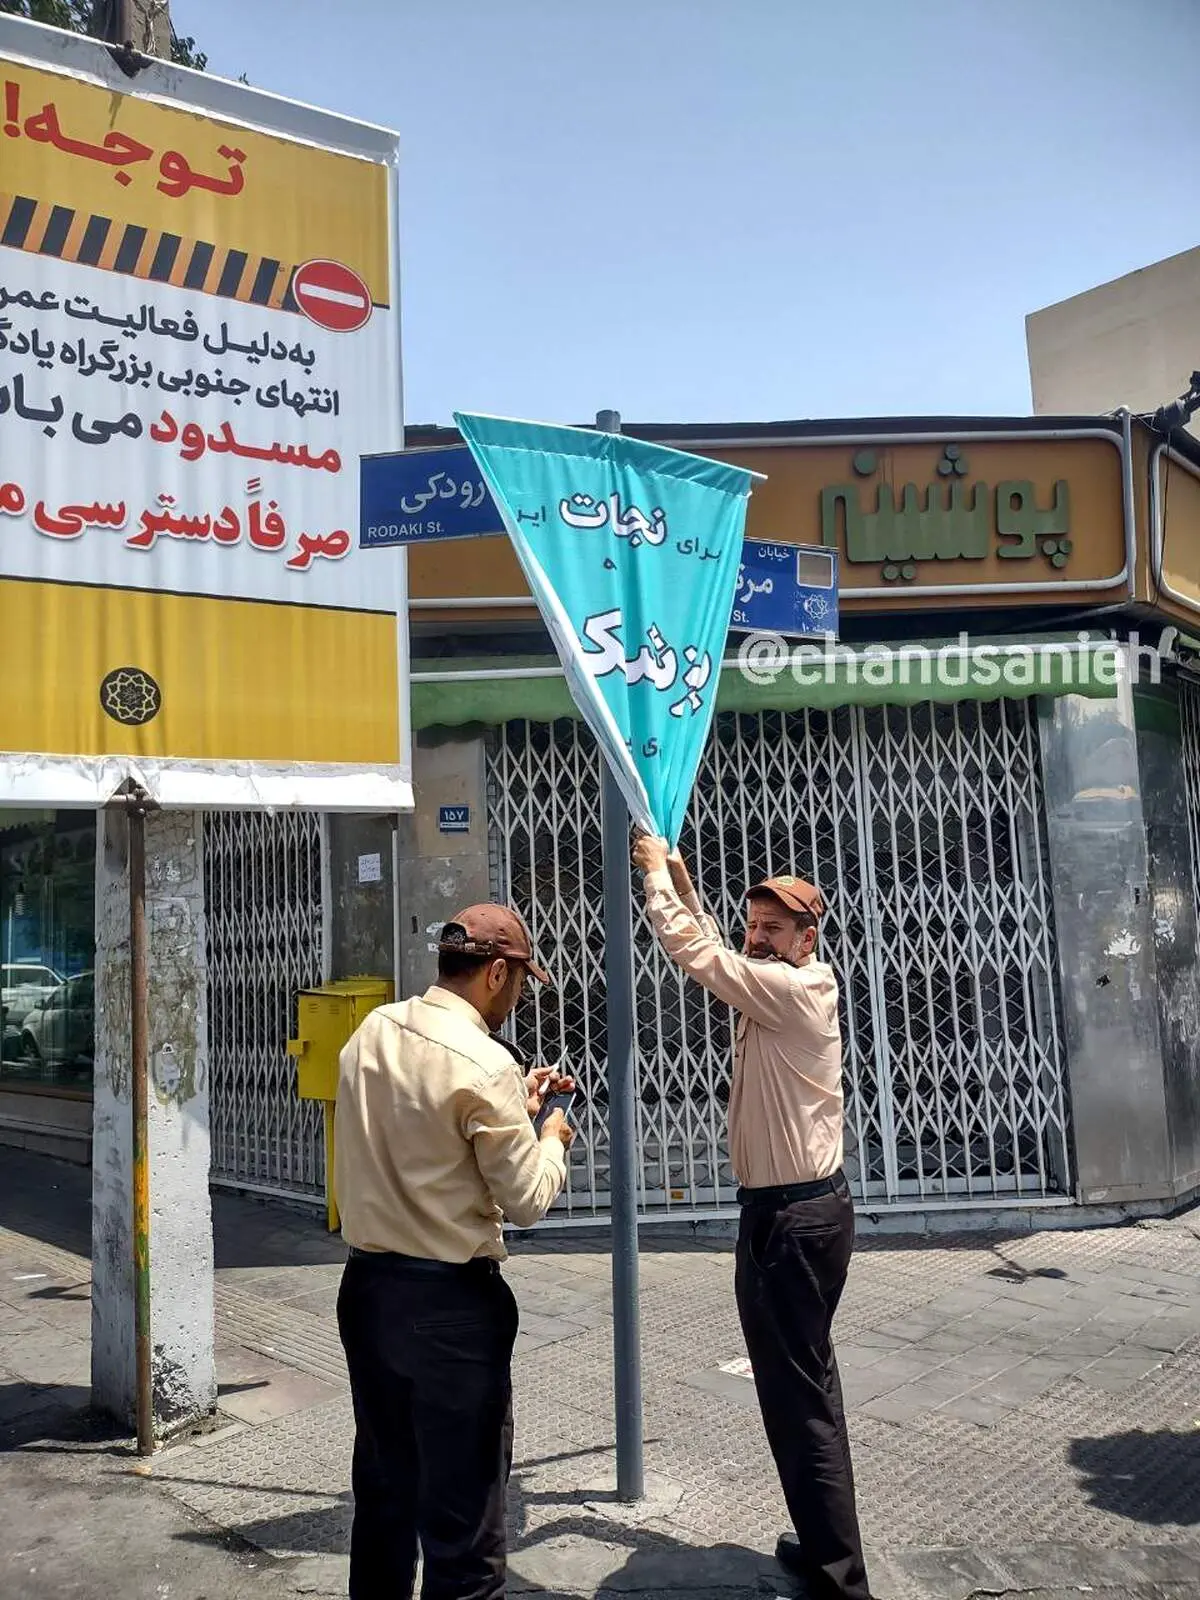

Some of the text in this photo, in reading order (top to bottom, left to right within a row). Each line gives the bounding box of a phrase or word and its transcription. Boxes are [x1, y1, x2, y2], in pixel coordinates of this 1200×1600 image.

[4, 80, 247, 198] توجه!
[64, 296, 199, 341] فعالیت
[60, 338, 153, 387] بزرگراه
[158, 366, 250, 406] جنوبی
[256, 380, 339, 416] انتهای
[72, 412, 143, 444] می
[150, 410, 342, 473] مسدود
[401, 472, 486, 513] رودکی
[34, 494, 242, 550] دسترسی
[368, 521, 445, 539] RODAKI St.
[559, 491, 667, 547] نجات
[677, 537, 722, 561] برای
[758, 546, 790, 562] خیابان
[733, 609, 749, 623] St.
[444, 810, 464, 821] ۱۵۷
